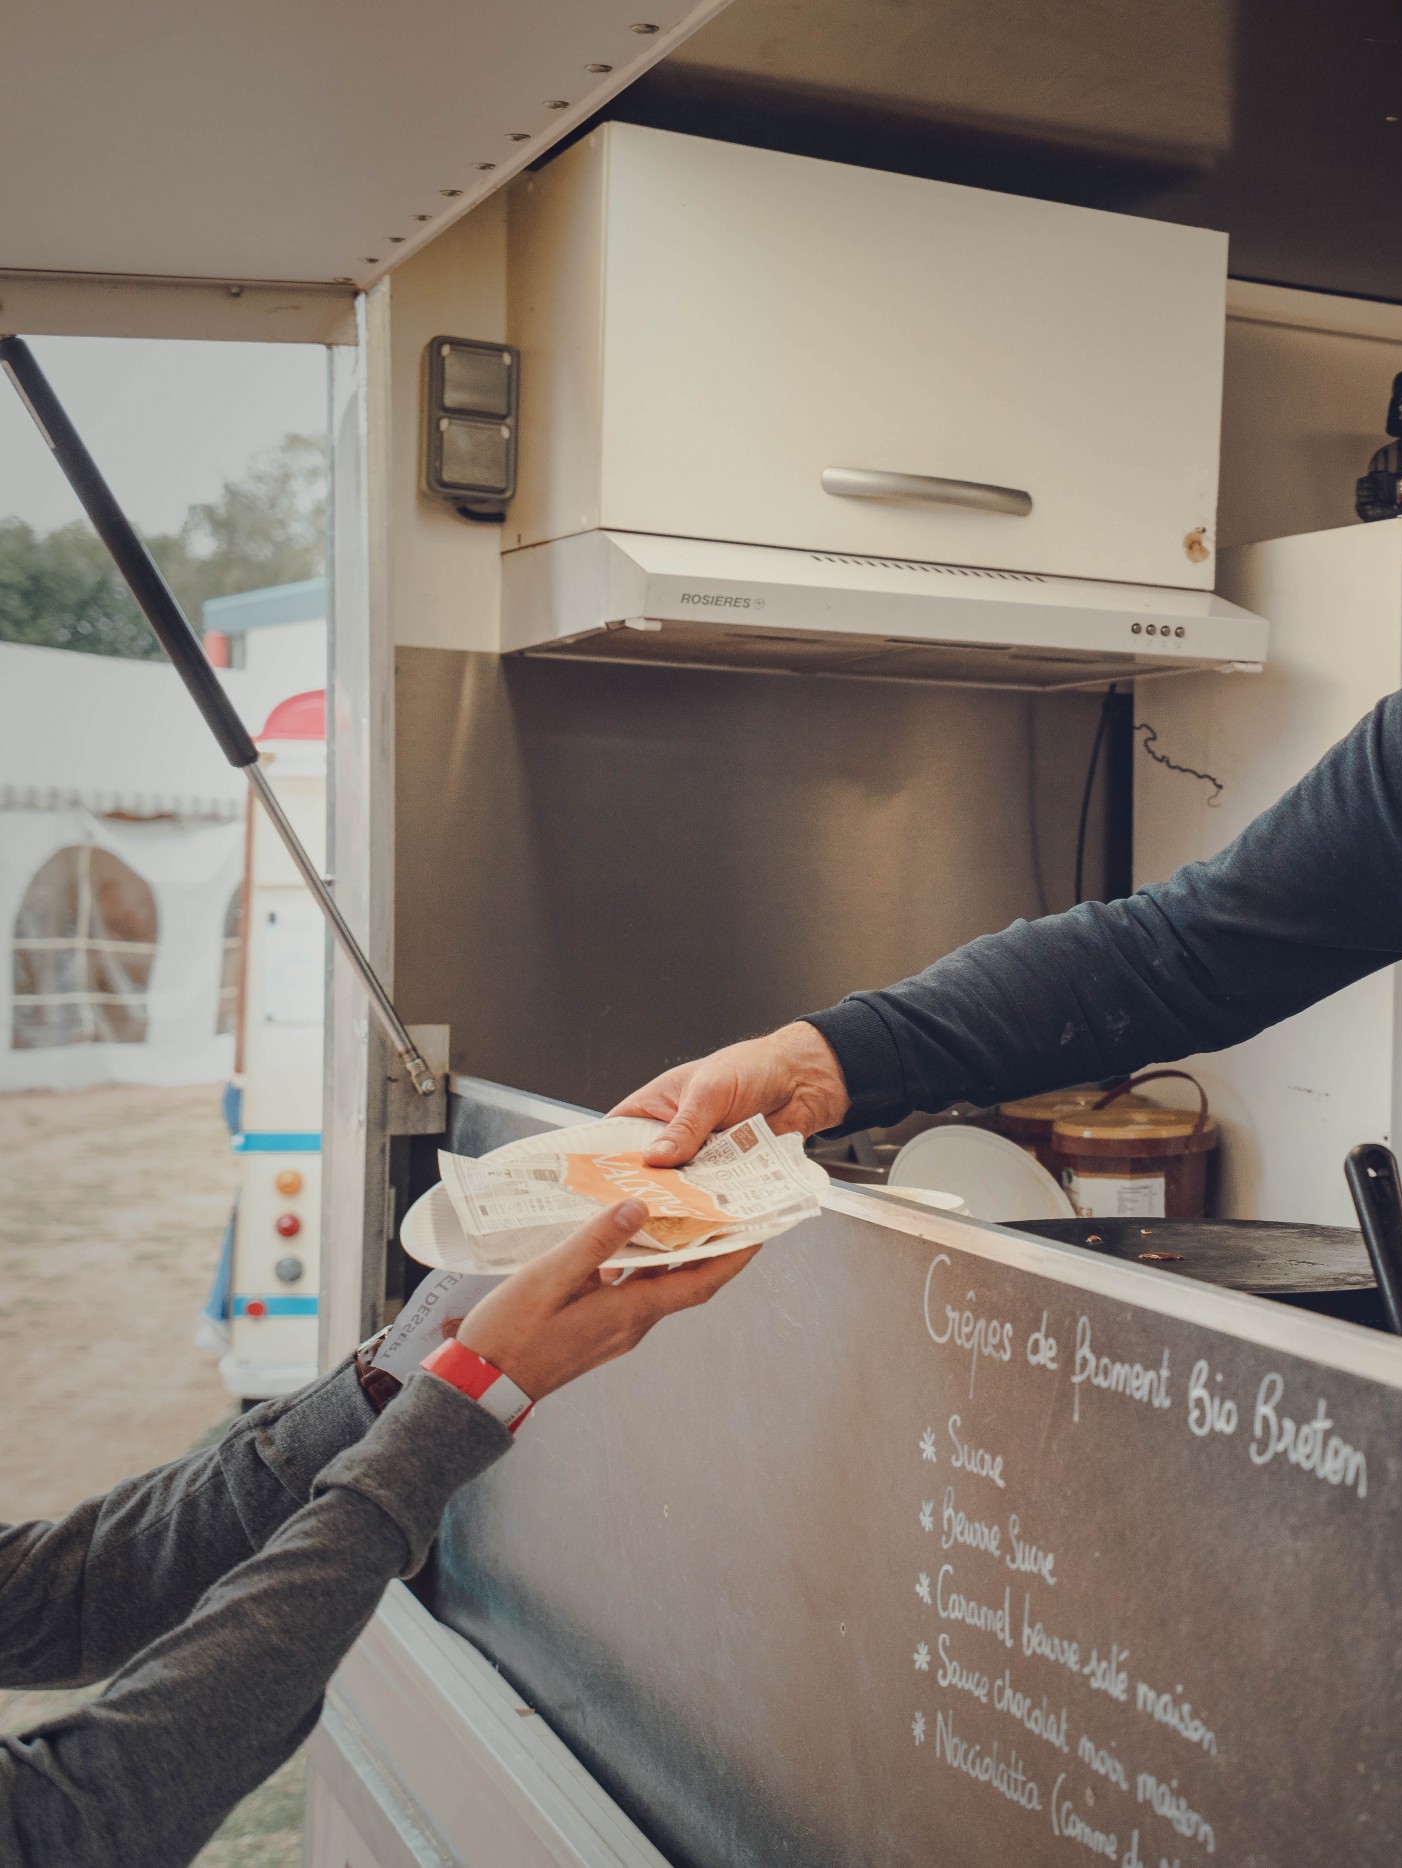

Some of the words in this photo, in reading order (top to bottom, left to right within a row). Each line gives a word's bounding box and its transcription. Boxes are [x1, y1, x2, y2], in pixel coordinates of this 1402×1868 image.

[924, 1254, 1014, 1399] Crêpes
[1027, 1310, 1057, 1370] de
[1188, 1359, 1239, 1438] Bio
[1249, 1372, 1368, 1499] Breton
[947, 1414, 1007, 1488] Sucre
[941, 1486, 1001, 1555] Beurre
[1005, 1514, 1056, 1585] Sucre
[936, 1565, 1014, 1648] Caramel
[1022, 1593, 1080, 1673] beurre
[1081, 1642, 1129, 1702] salé
[1135, 1683, 1217, 1756] maison
[936, 1633, 990, 1704] Sauce
[993, 1667, 1070, 1754] chocolat
[1077, 1733, 1129, 1792] noir
[935, 1709, 1043, 1811] Nocciolatta
